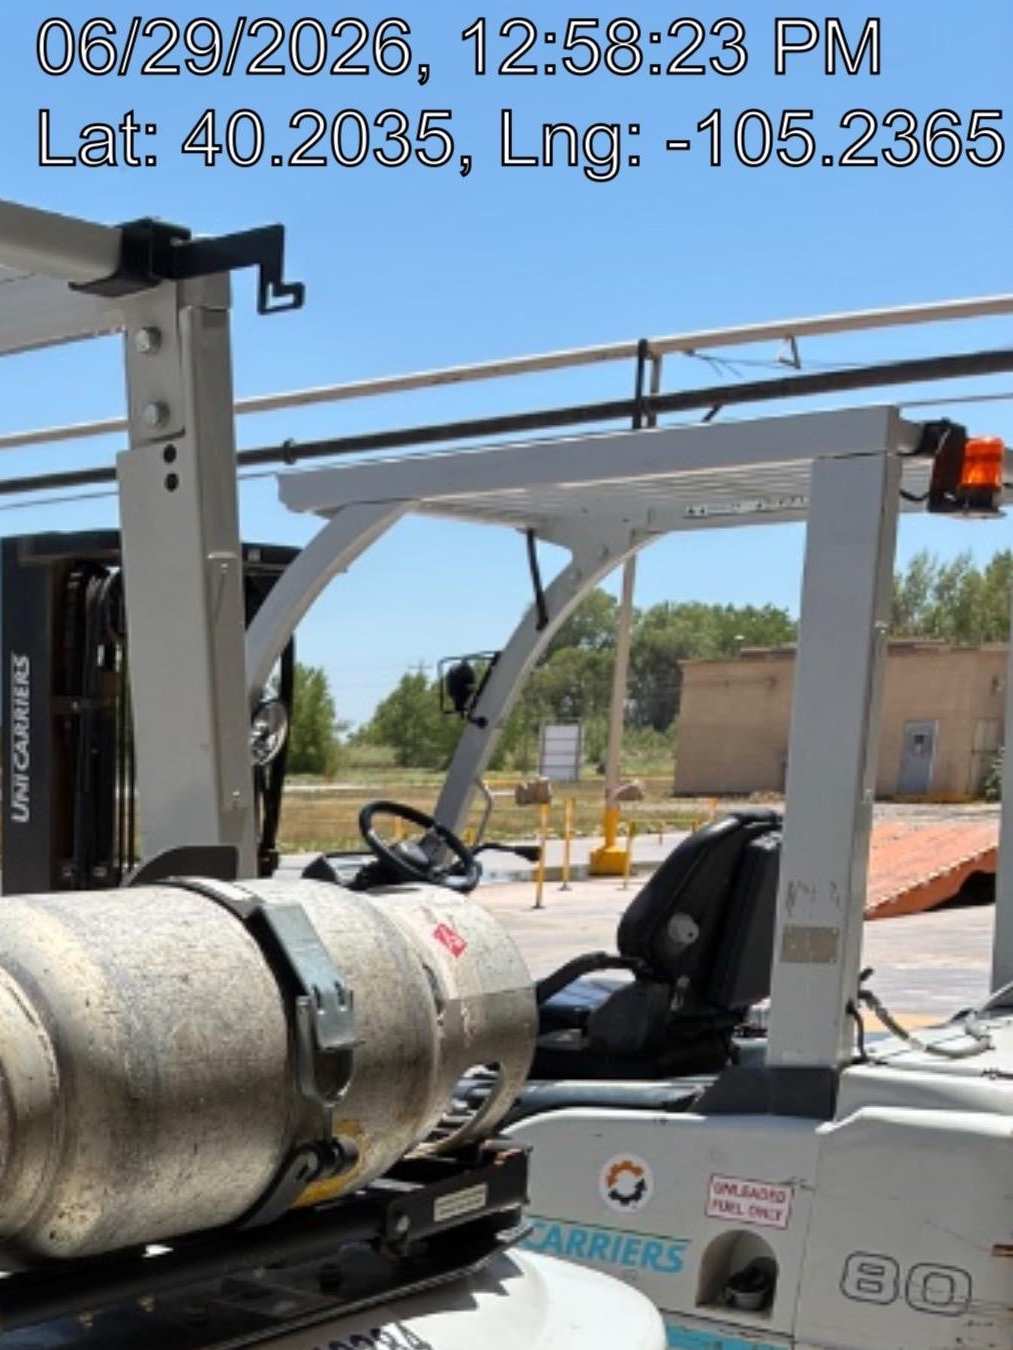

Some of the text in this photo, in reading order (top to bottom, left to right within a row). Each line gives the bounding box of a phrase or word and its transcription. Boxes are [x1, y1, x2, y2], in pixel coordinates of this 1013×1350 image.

[714, 1182, 786, 1203] UNLEADED
[712, 1199, 782, 1221] FUEL ONLY
[840, 1251, 972, 1317] 80
